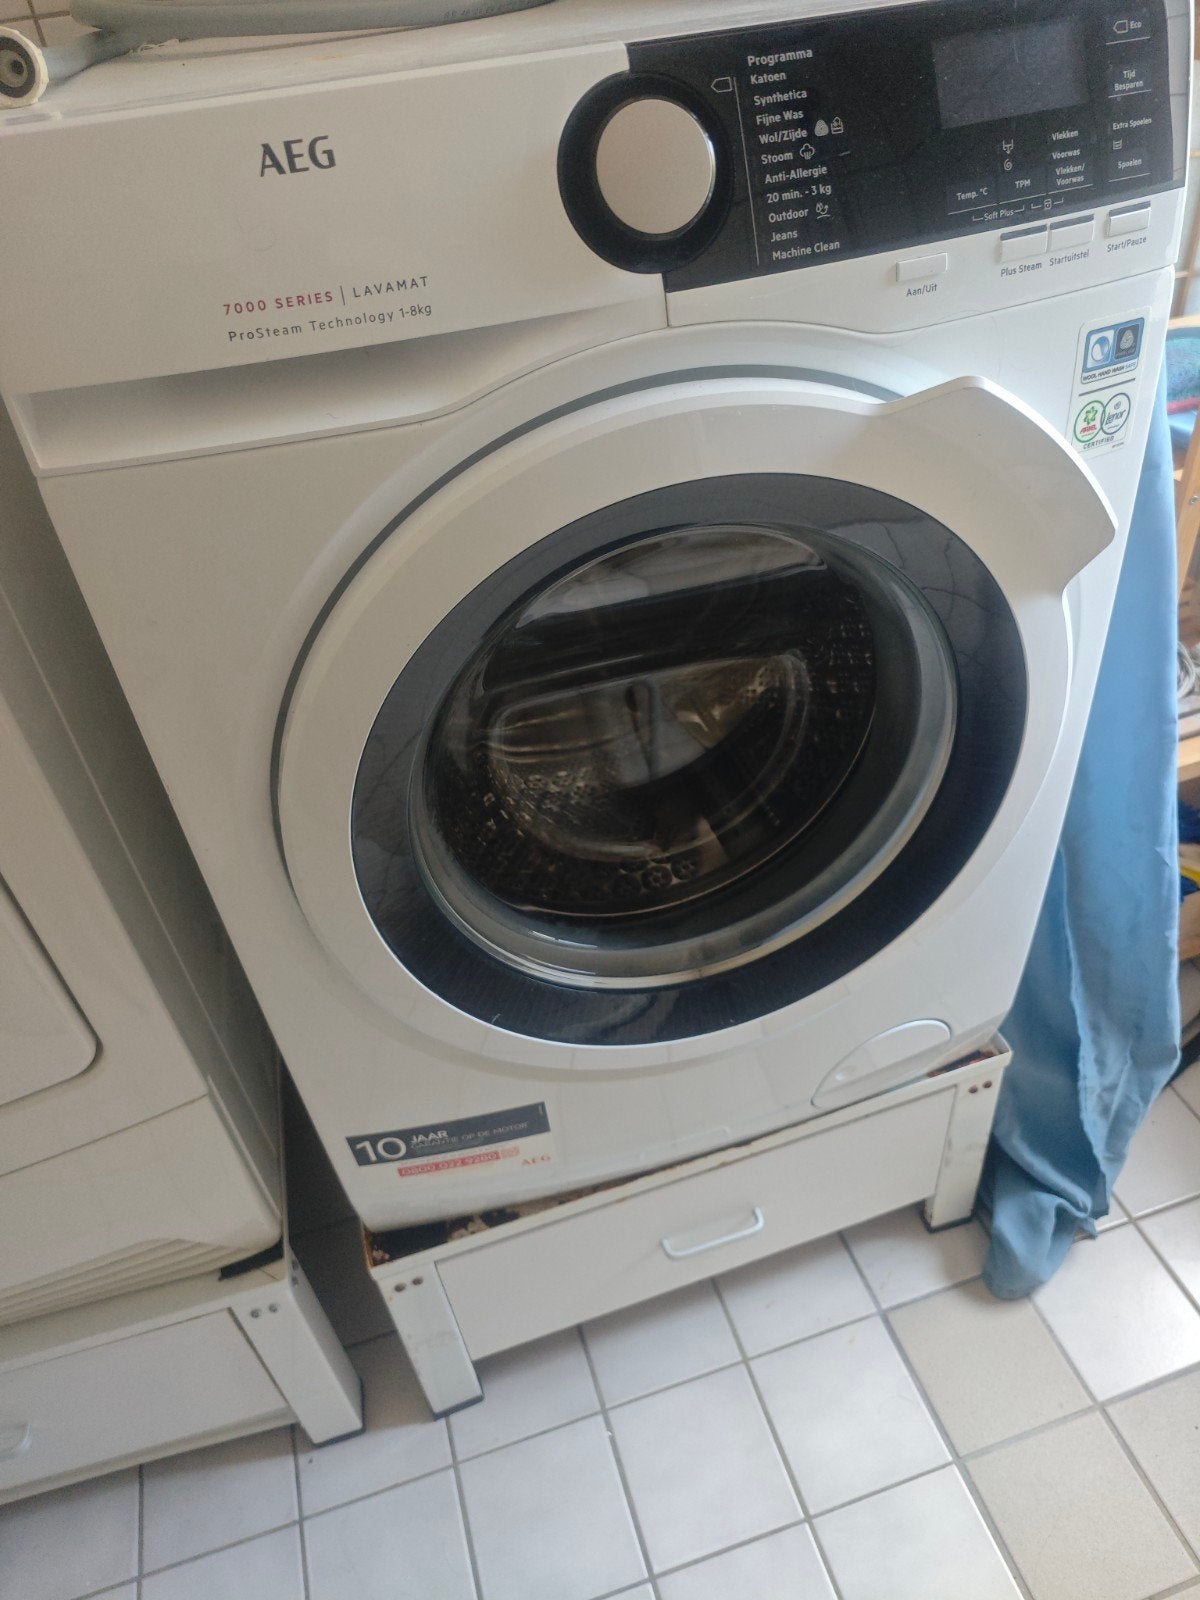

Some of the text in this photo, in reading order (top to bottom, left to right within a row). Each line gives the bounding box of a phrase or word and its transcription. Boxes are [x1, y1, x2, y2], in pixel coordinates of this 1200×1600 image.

[1130, 21, 1142, 29] Eco
[747, 49, 813, 67] Programma
[750, 72, 787, 84] Katoen
[1123, 69, 1136, 79] Tijd
[1114, 80, 1144, 91] Besparen
[754, 90, 808, 106] Synthetica
[756, 110, 804, 126] Fijne Was
[1113, 117, 1152, 130] Extra Spoelen
[759, 128, 808, 144] Wol/Zijde
[1052, 130, 1079, 140] Vlekken
[259, 135, 337, 177] AEG
[761, 152, 793, 164] Stoom
[1052, 149, 1081, 159] Voorwas
[1055, 163, 1085, 175] Vlekken/
[1118, 158, 1142, 169] Spoelen
[764, 165, 828, 184] Anti-Allergie
[1056, 175, 1085, 186] Voorwas
[1015, 179, 1031, 188] TPM
[767, 192, 779, 203] 20
[781, 189, 803, 200] min.
[811, 185, 817, 196] 3
[819, 184, 832, 195] kg
[956, 191, 978, 201] Temp.
[768, 208, 809, 223] Outdoor
[984, 208, 1014, 221] Soft Plus
[770, 230, 798, 242] Jeans
[772, 241, 840, 261] Machine Clean
[1107, 236, 1147, 252] Start/Pauze
[1050, 249, 1090, 266] Startuitstel
[1001, 262, 1042, 277] Plus Steam
[223, 275, 428, 316] 7000 SERIES LAVAMAT
[906, 283, 937, 297] Aan/Uit
[228, 303, 433, 342] ProSteam Technology 1-8kg
[1082, 435, 1115, 449] CERTIFIED
[411, 1130, 449, 1144] JAAR
[462, 1133, 475, 1142] OP
[477, 1130, 490, 1138] DE
[493, 1121, 529, 1135] MOTOR
[356, 1137, 407, 1163] 10
